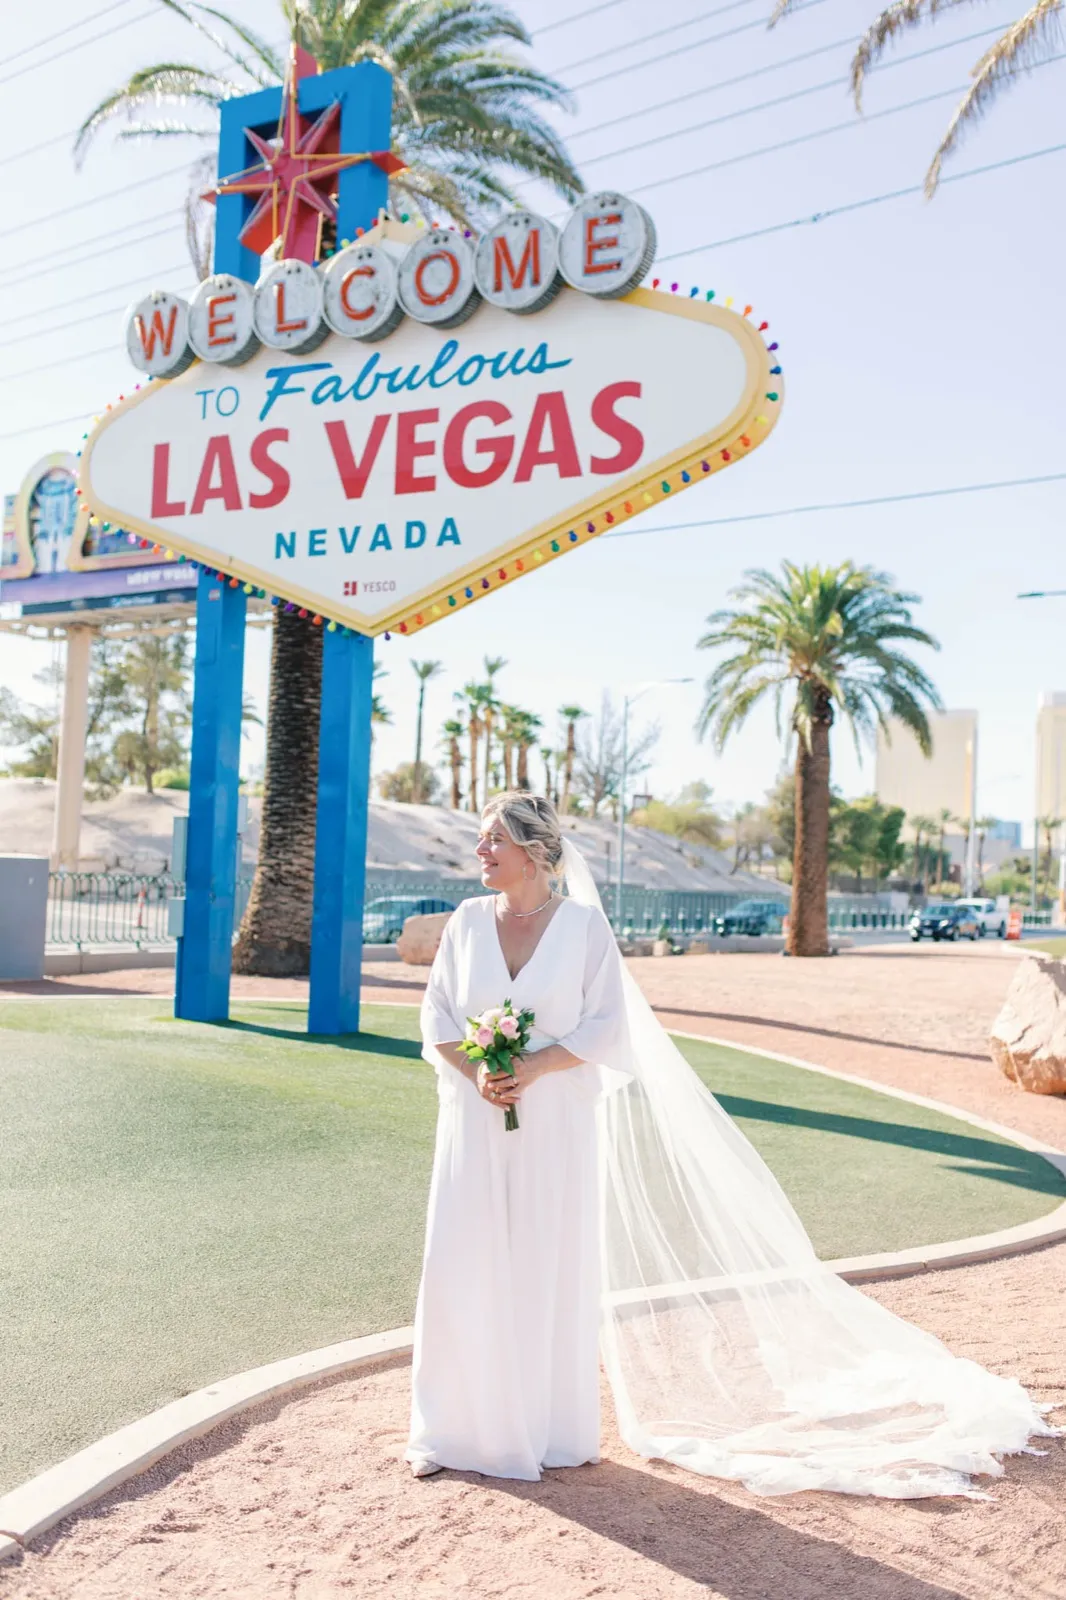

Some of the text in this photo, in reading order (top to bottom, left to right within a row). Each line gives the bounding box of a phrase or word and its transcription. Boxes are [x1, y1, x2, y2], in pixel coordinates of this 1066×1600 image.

[135, 213, 622, 361] WELCOME
[195, 339, 573, 421] TO Fabulous
[151, 381, 645, 519] LAS VEGAS
[274, 516, 462, 560] NEVADA
[362, 580, 397, 593] YESCO
